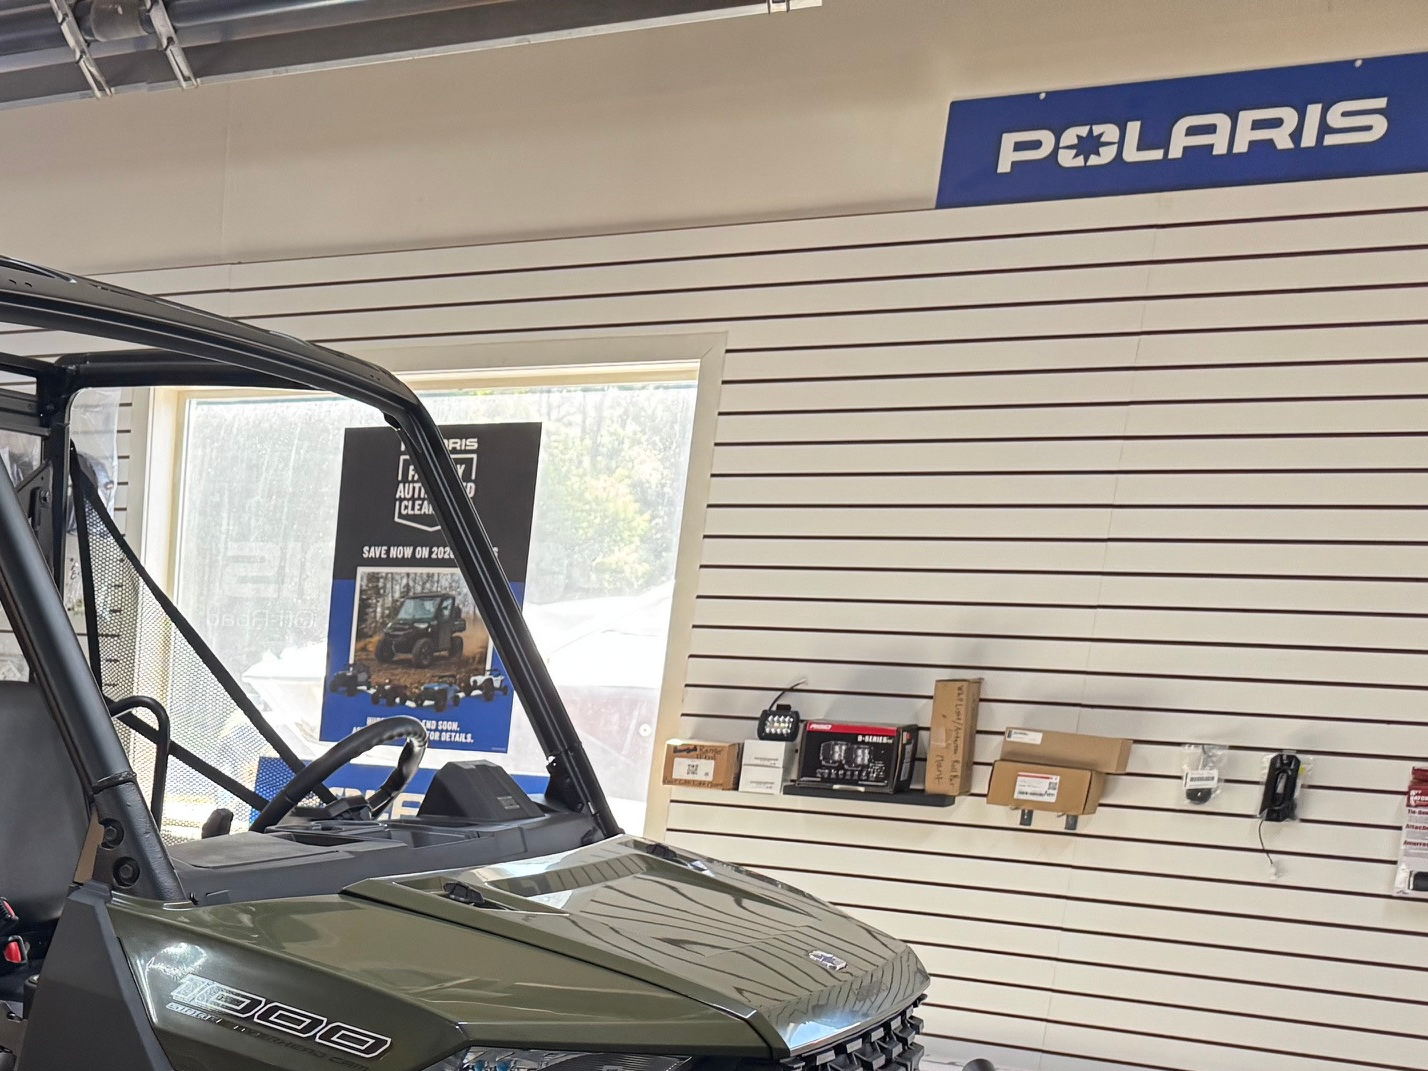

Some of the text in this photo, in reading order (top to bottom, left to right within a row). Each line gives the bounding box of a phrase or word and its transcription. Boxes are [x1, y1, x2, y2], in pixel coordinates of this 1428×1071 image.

[996, 97, 1389, 174] POLARIS
[362, 546, 387, 559] SAVE
[389, 546, 414, 559] NOW
[415, 546, 430, 559] ON
[441, 732, 474, 743] DETAILS.
[170, 973, 392, 1058] 1000
